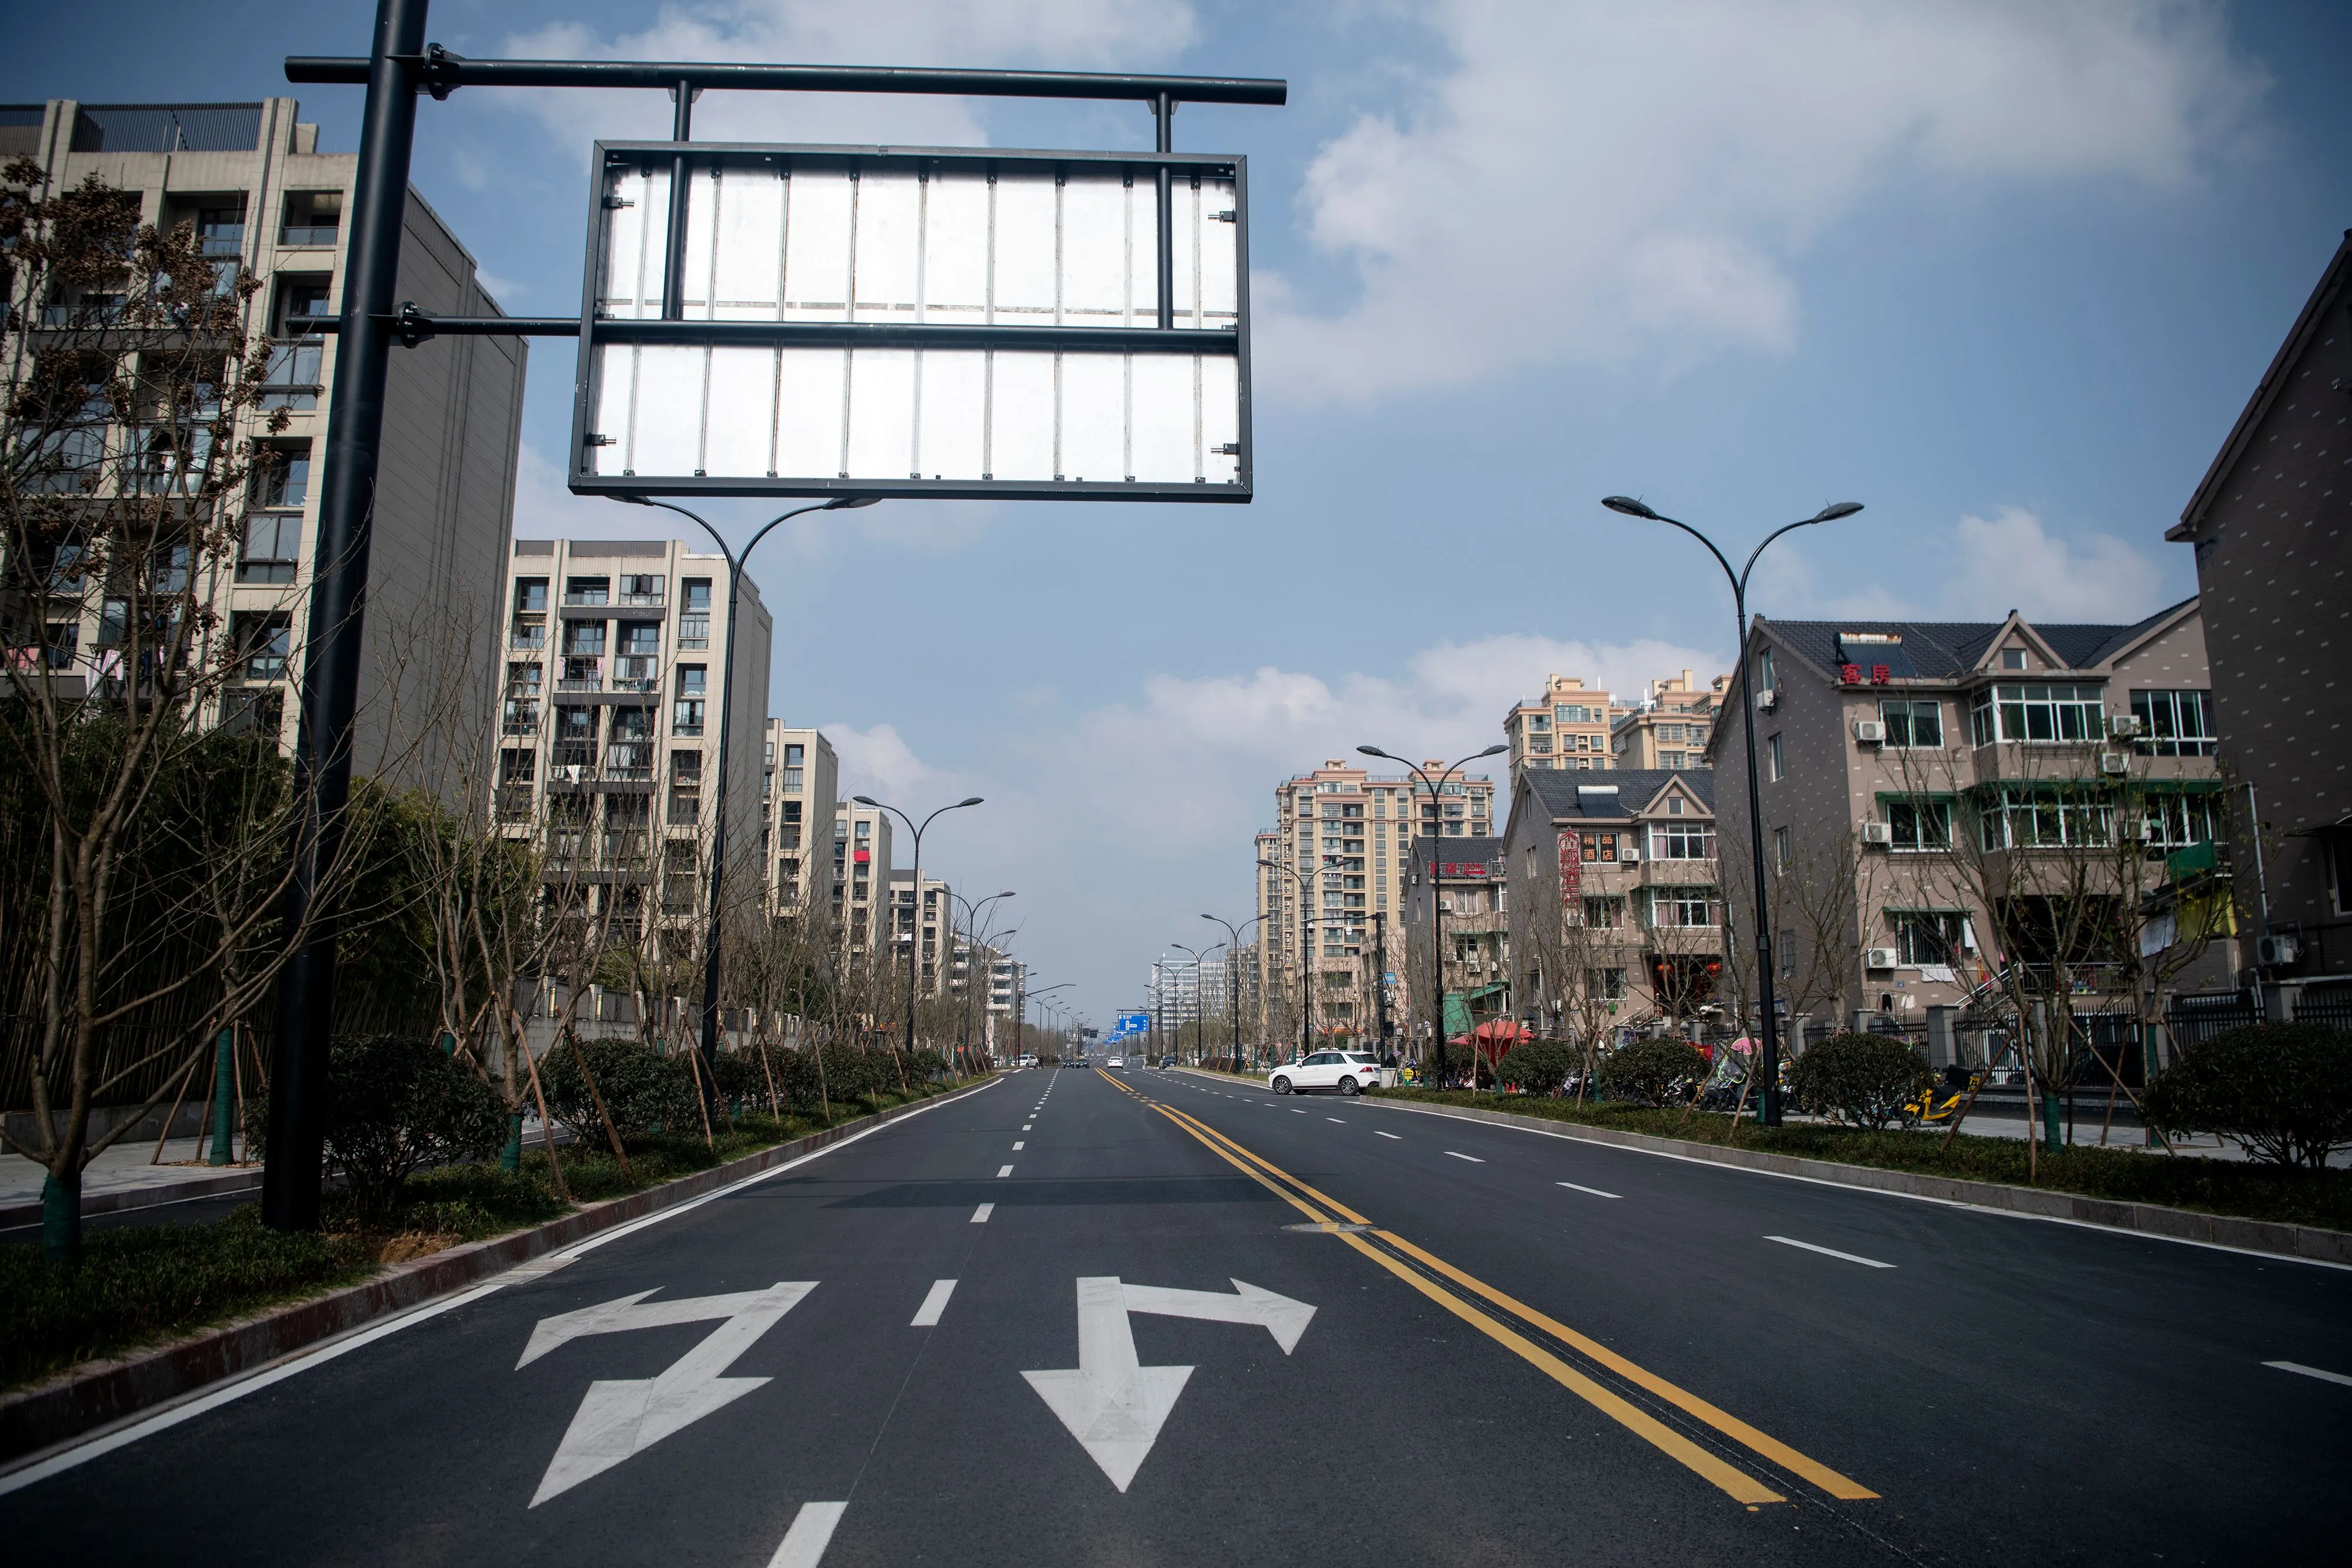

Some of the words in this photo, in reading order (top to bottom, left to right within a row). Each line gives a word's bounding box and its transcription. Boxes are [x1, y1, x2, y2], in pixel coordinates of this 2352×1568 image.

[1841, 663, 1890, 684] 客房
[1583, 834, 1613, 845] 精品
[1584, 849, 1613, 861] 酒店
[1558, 826, 1580, 908] 杰翔酒店
